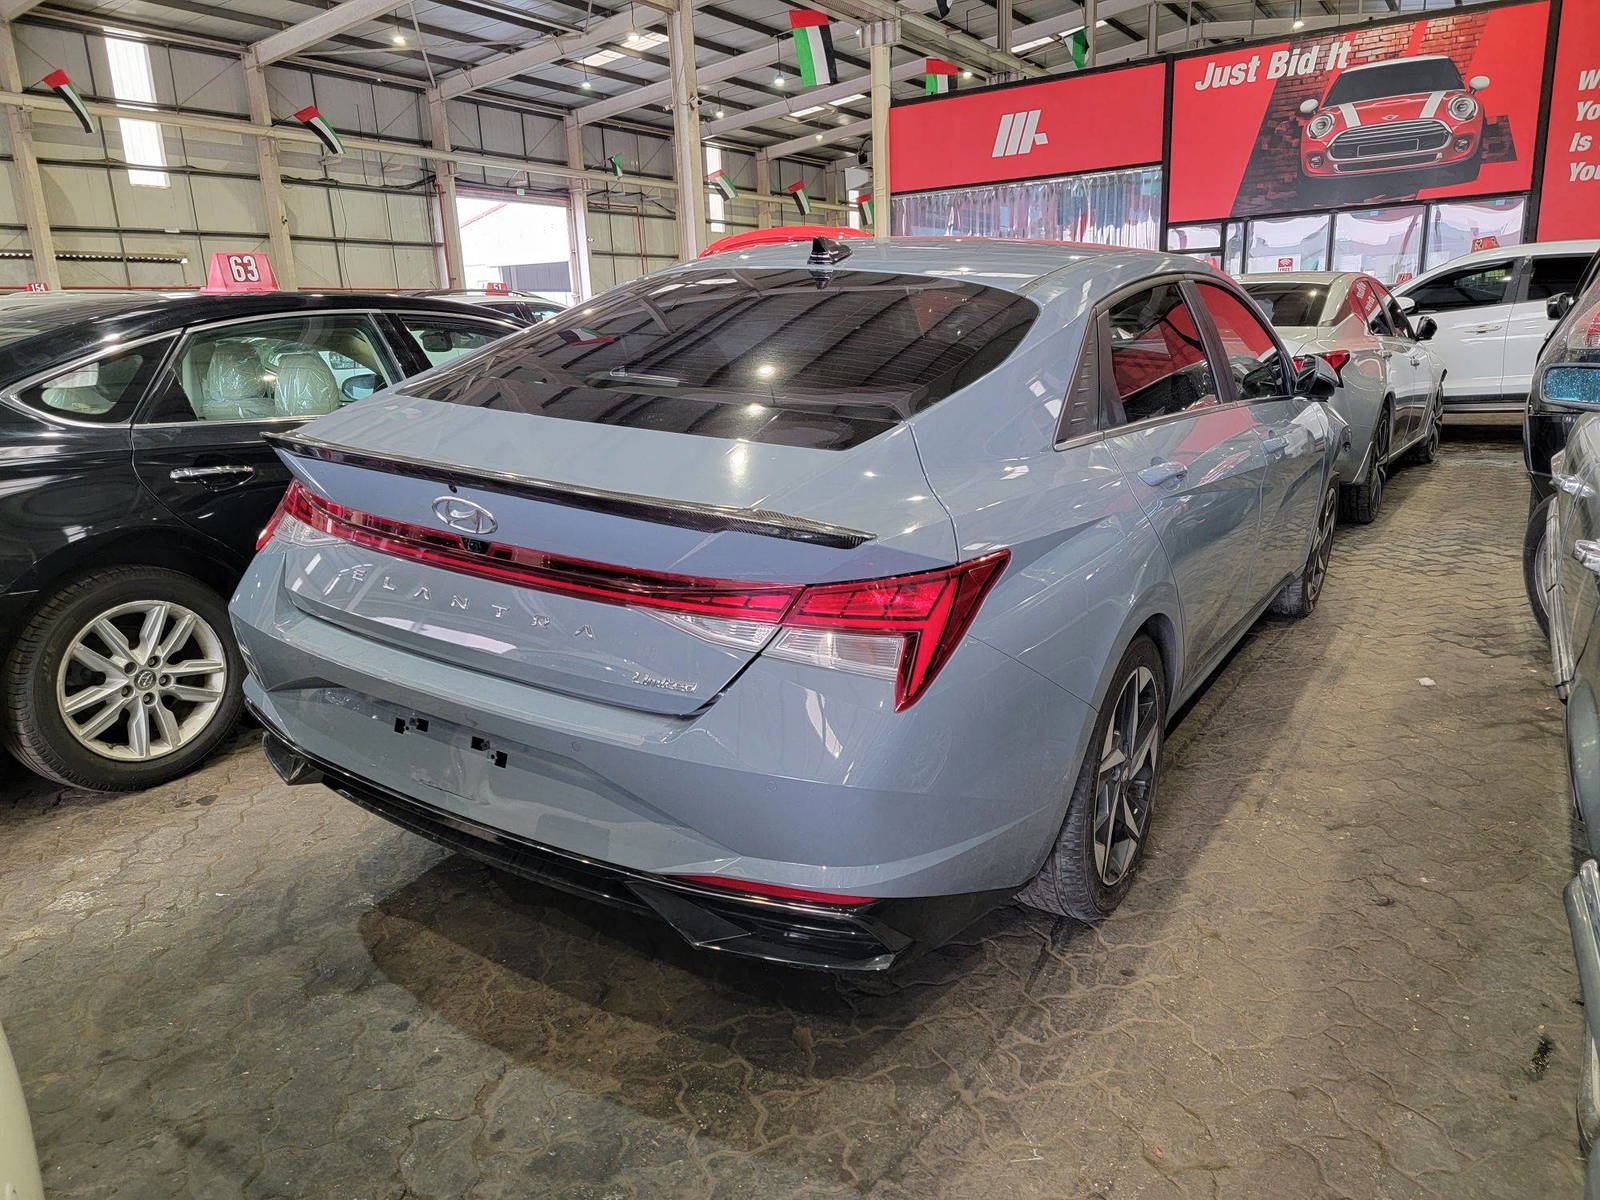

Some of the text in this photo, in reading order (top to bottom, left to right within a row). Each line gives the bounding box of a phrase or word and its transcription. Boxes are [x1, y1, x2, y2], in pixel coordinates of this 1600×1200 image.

[1195, 40, 1351, 91] Just Bid It
[1569, 132, 1592, 152] Is
[229, 255, 259, 282] 63
[352, 568, 595, 640] ELANTRA
